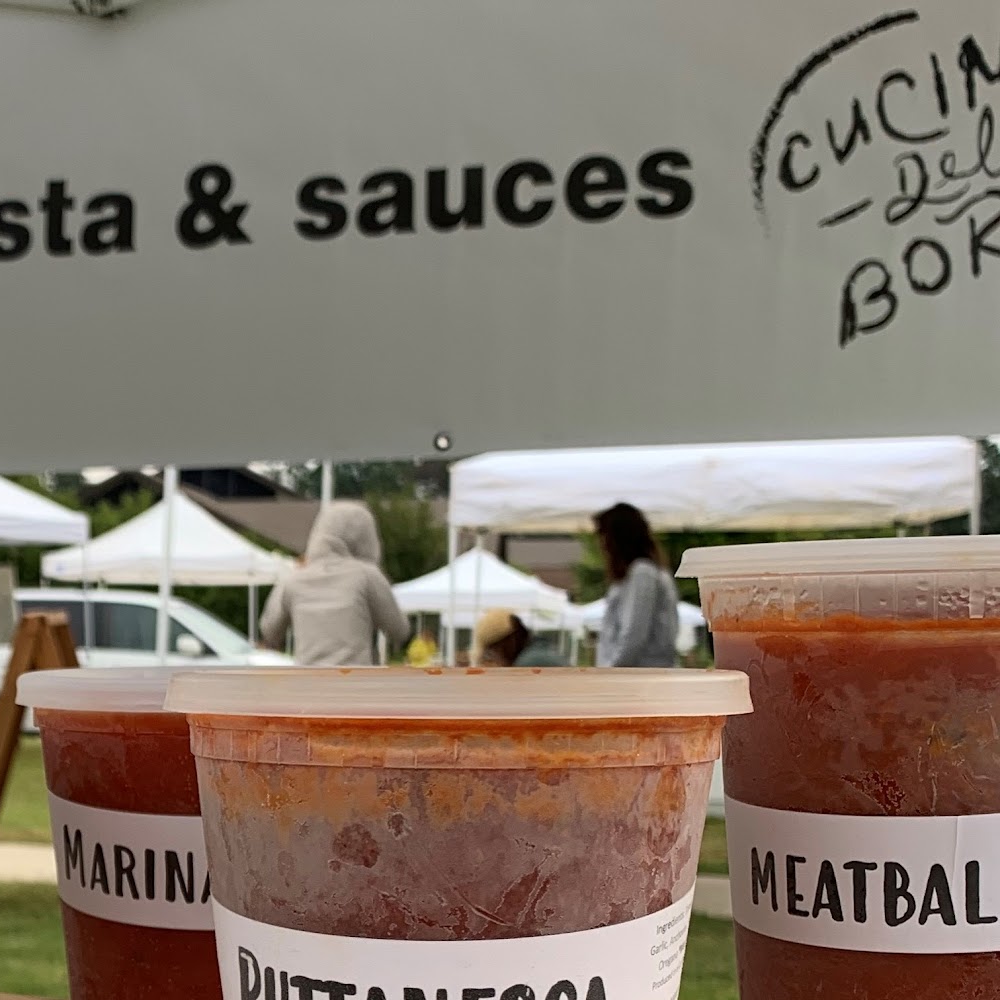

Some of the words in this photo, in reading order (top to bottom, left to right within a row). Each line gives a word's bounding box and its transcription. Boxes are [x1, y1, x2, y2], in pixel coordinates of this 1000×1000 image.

[175, 162, 252, 249] &
[295, 149, 693, 240] sauces
[751, 847, 998, 927] MEATBAL
